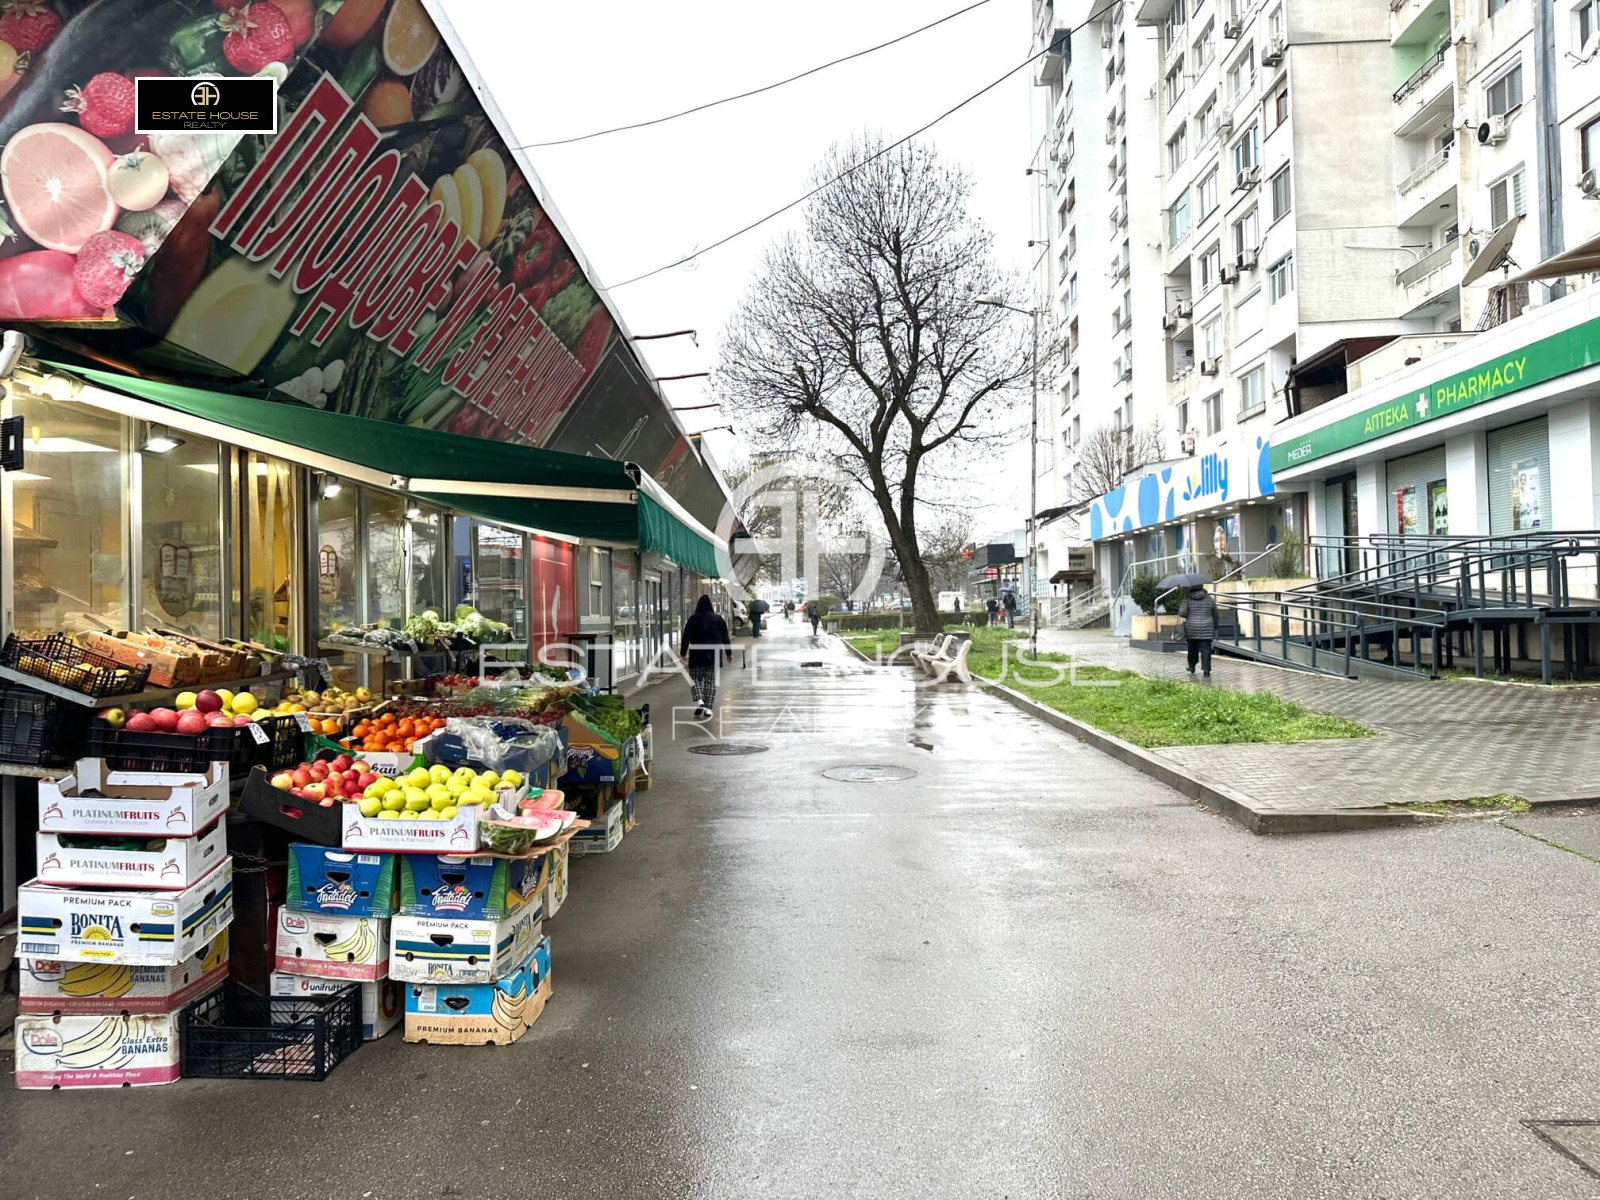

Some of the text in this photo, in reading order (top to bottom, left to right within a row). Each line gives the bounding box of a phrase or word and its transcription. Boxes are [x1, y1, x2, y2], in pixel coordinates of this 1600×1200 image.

[208, 70, 587, 444] ПЛОДОВЕ И ЗЕЛЕНЧУЦИ
[1437, 357, 1527, 408] PHARMACY
[1364, 403, 1408, 434] АПТЕКА
[1201, 452, 1228, 501] lilly
[72, 809, 160, 820] PLATINUMFRUITS
[370, 827, 445, 838] PLATINUMFRUITS
[70, 859, 155, 872] PLATINUMFRUITS
[63, 896, 132, 907] PREMIUM PACK
[70, 912, 124, 938] BONITA
[286, 917, 305, 928] Dole
[417, 920, 448, 928] PREMIUM
[35, 960, 61, 972] Dole
[130, 965, 165, 974] PREMIUM
[130, 974, 166, 983] BANANAS
[416, 1025, 498, 1034] PREMIUM BANANAS
[31, 1034, 58, 1046] Dole
[121, 1036, 168, 1045] Class Extra
[121, 1044, 168, 1055] BANANAS
